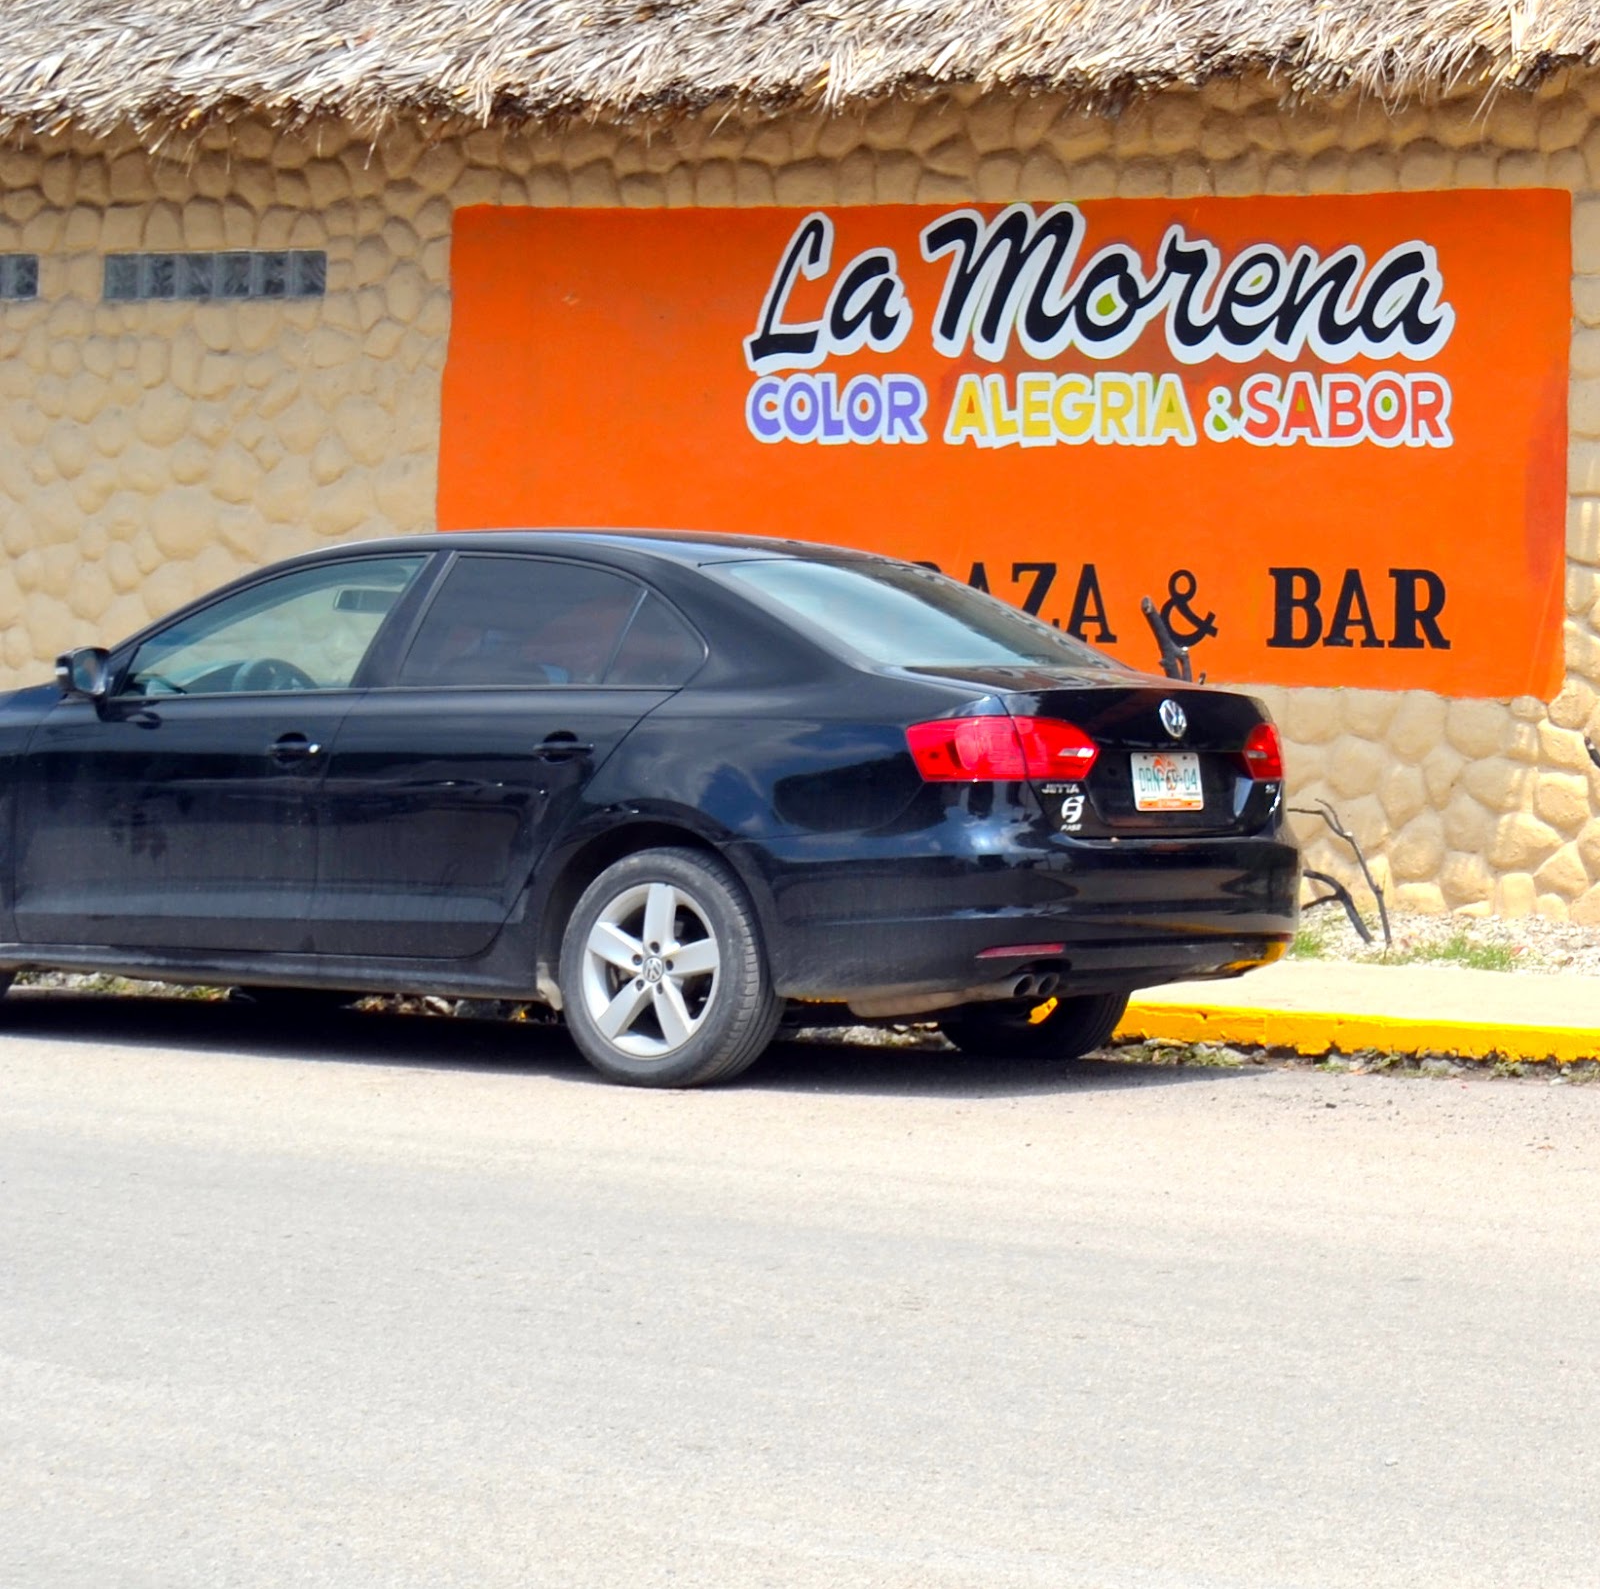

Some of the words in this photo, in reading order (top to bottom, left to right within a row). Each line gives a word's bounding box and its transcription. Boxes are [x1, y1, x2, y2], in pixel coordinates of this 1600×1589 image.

[743, 210, 913, 372] La
[919, 202, 1456, 364] Morena
[746, 373, 928, 445] COLOR
[943, 372, 1197, 448] ALEGRIA
[1266, 567, 1451, 650] BAR
[1041, 783, 1080, 794] JETTA
